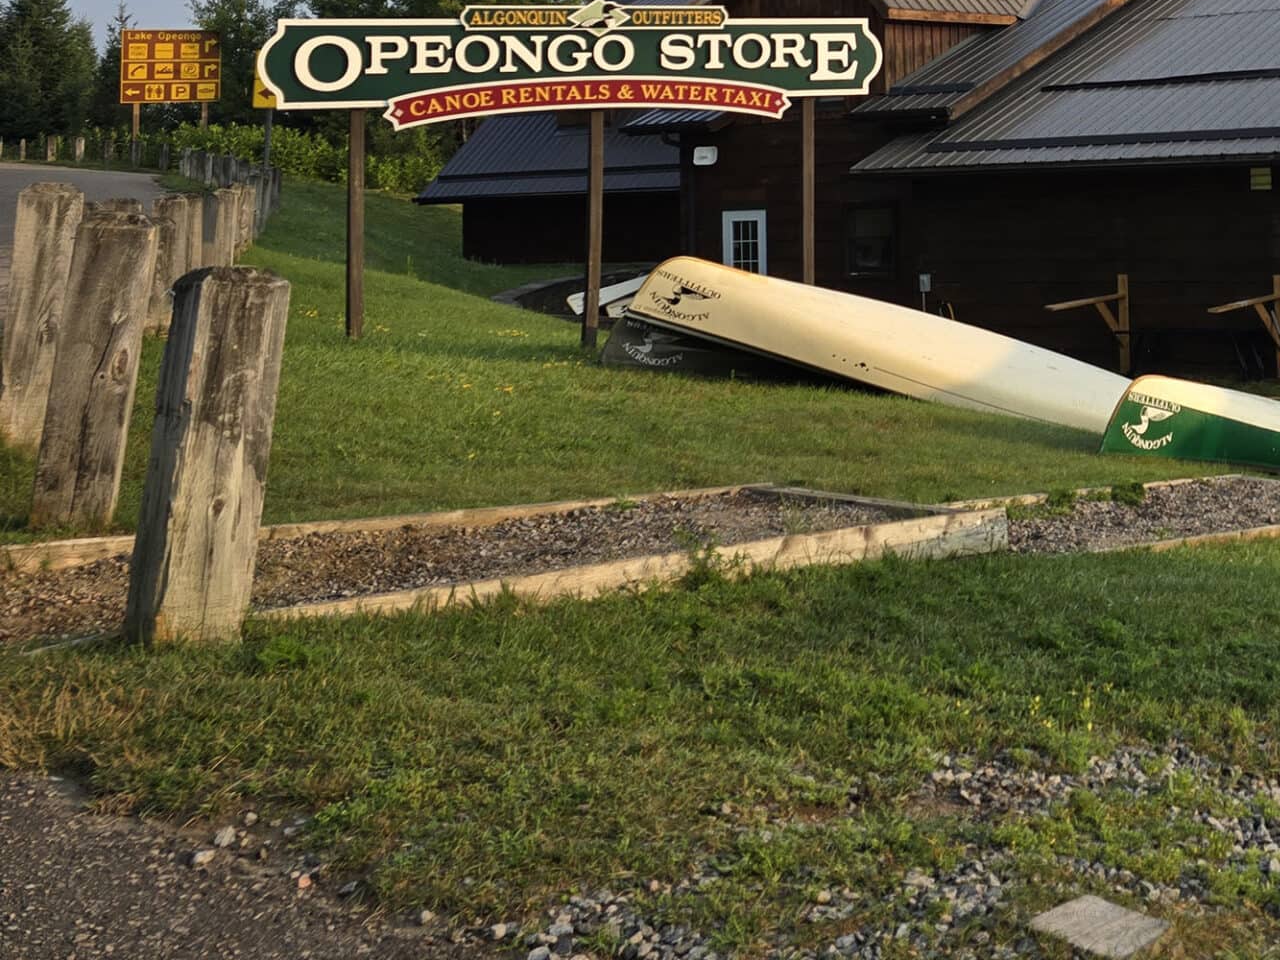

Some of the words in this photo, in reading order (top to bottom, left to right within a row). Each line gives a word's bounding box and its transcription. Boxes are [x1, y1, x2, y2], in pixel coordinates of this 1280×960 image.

[470, 11, 567, 25] ALGONQUIN
[632, 10, 722, 25] OUTFITTERS
[127, 31, 153, 40] Lake
[158, 31, 202, 41] Opeongo
[294, 34, 634, 91] OPEONGO
[660, 32, 858, 81] STORE
[409, 91, 494, 117] CANOE
[501, 84, 611, 106] RENTALS
[616, 84, 634, 100] &
[640, 84, 718, 103] WATER
[720, 90, 771, 108] TAXI
[657, 269, 722, 300] OUTFITTERS
[649, 291, 711, 321] ALGONQUIN
[622, 342, 684, 367] ALGONQUIN
[1128, 391, 1181, 413] OUTFITTERS
[1122, 422, 1174, 450] ALGONQUIN
